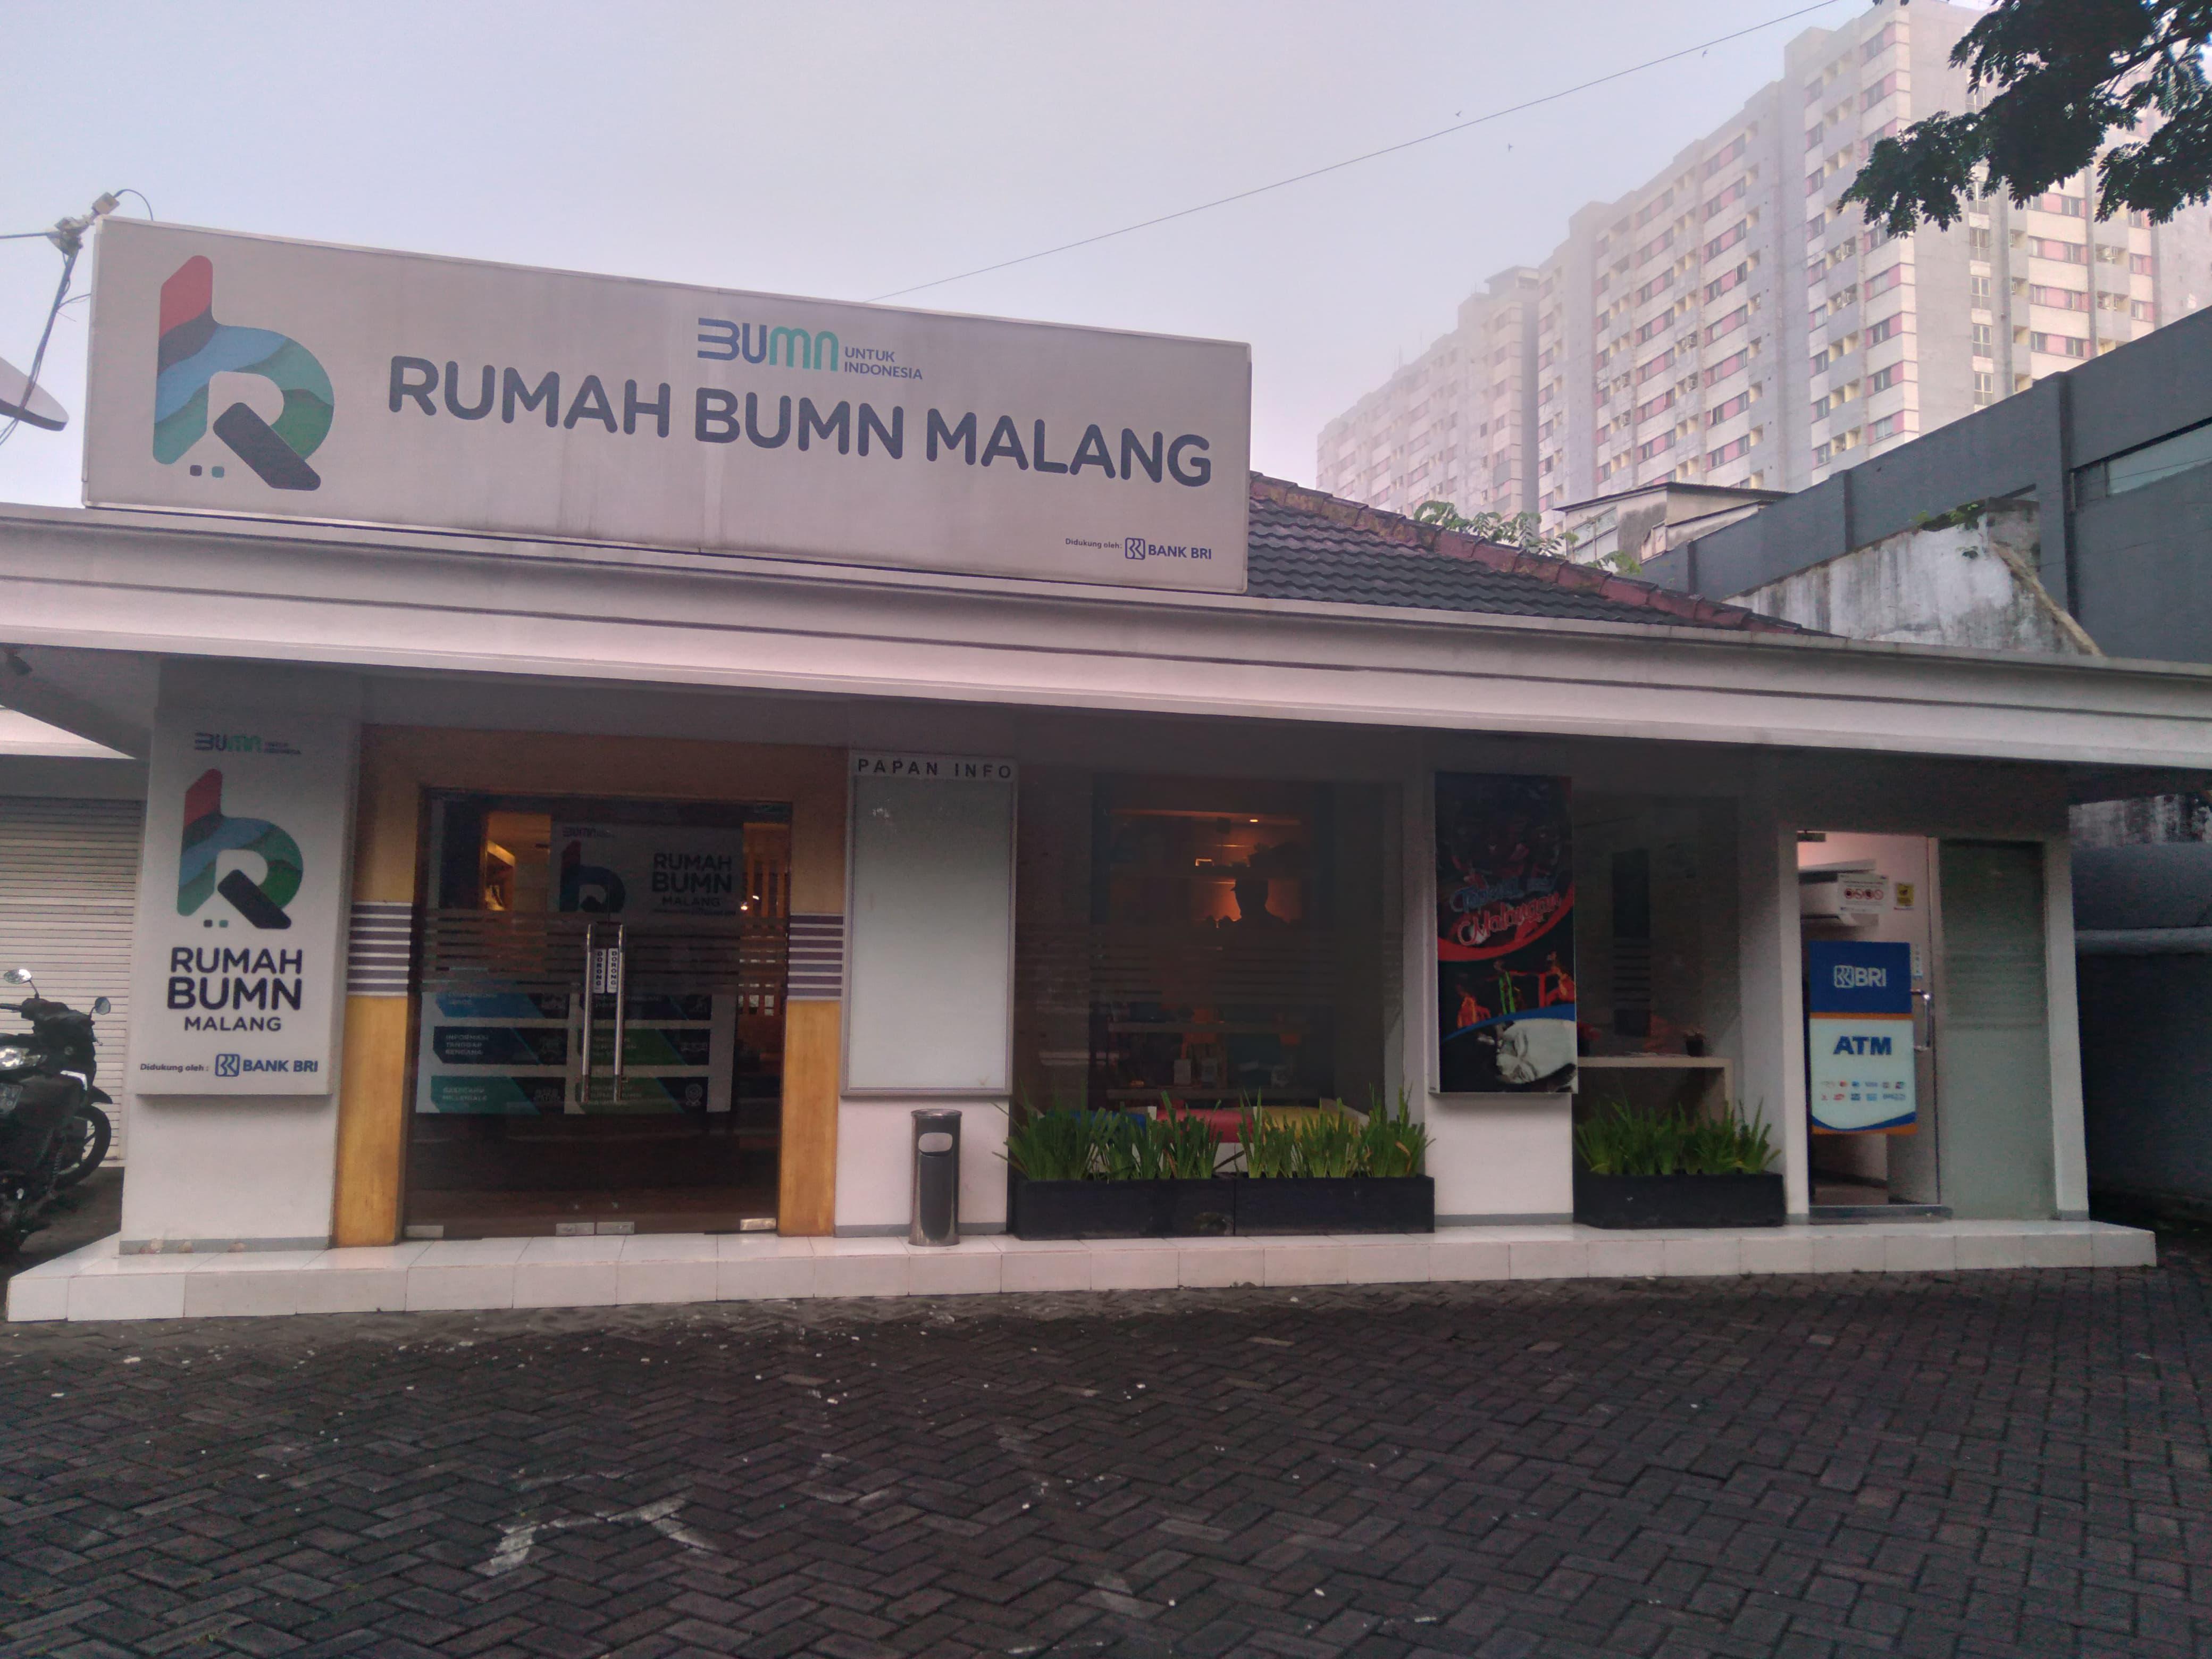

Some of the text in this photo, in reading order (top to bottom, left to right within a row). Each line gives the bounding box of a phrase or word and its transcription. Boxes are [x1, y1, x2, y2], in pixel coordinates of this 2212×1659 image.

[844, 346, 895, 363] UNTUK
[844, 362, 923, 380] INDONESIA
[389, 356, 1211, 487] RUMAH BUMN MALANG
[1065, 538, 1102, 549] Didukung
[1149, 544, 1186, 558] BANK
[1191, 548, 1212, 559] BRI
[858, 758, 1011, 779] PAPAN INFO
[653, 852, 732, 872] RUMAH
[652, 872, 733, 894] BUMN
[662, 896, 720, 908] MALANG
[170, 946, 303, 975] RUMAH
[1855, 967, 1887, 987] BRI
[167, 977, 303, 1011] BUMN
[184, 1016, 282, 1032] MALANG
[1833, 1036, 1892, 1055] ATM
[140, 1063, 183, 1073] Didukung
[242, 1059, 289, 1073] BANK
[293, 1060, 319, 1073] BRI
